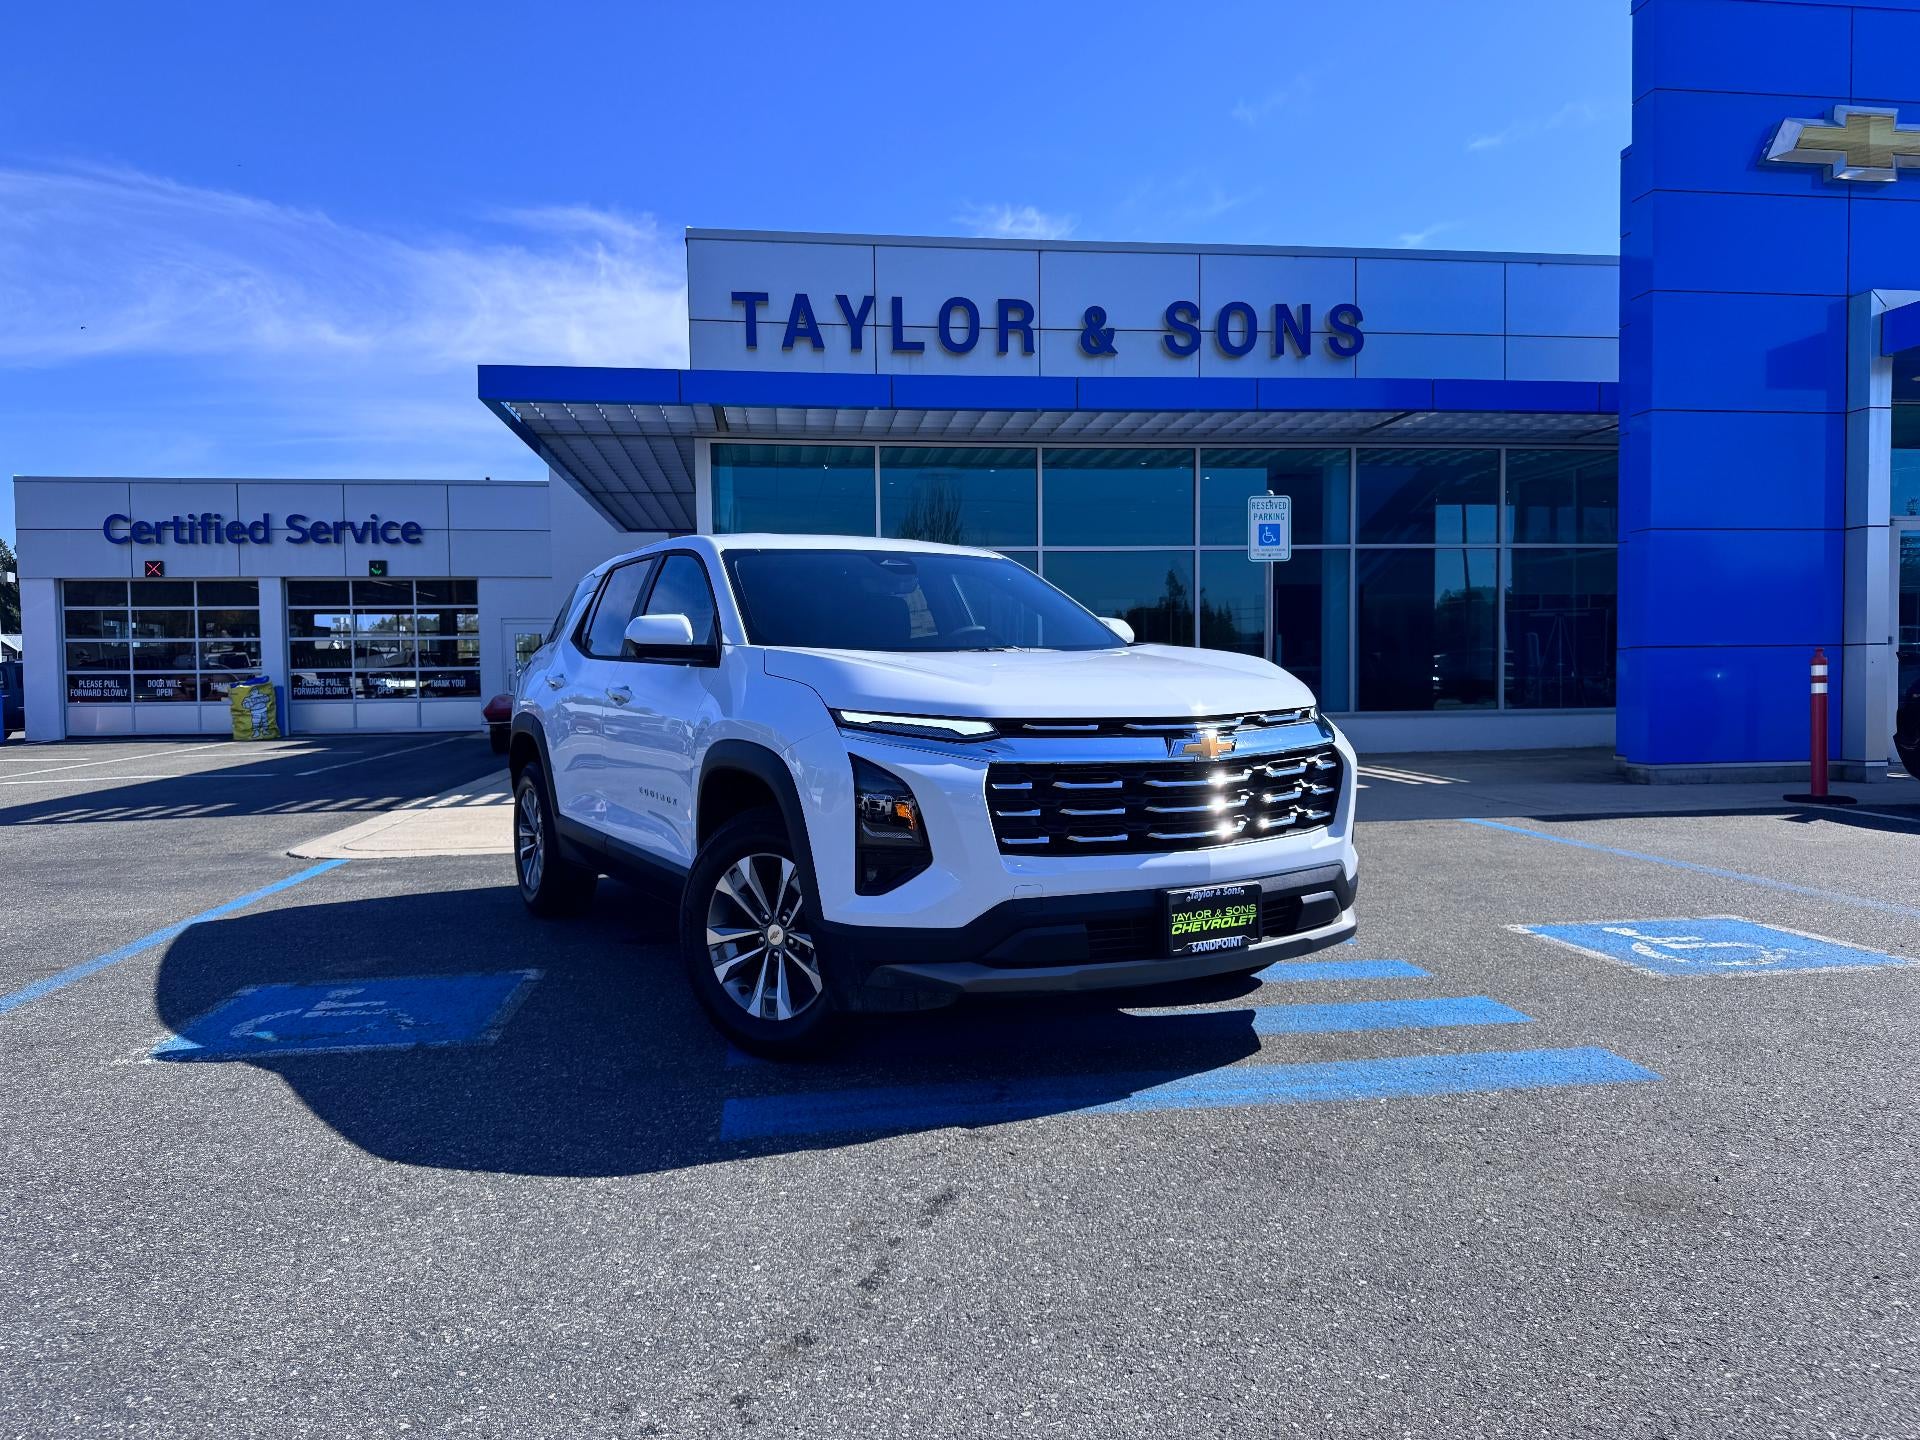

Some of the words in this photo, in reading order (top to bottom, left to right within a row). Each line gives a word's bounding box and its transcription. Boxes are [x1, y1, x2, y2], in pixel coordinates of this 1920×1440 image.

[731, 291, 1035, 355] TAYLOR
[1081, 305, 1118, 355] &
[1164, 302, 1365, 358] SONS
[1251, 501, 1287, 509] RESERVED
[1253, 512, 1285, 521] PARKING
[103, 512, 271, 545] Certified
[286, 513, 422, 545] Service
[78, 679, 103, 688] PLEASE
[104, 679, 120, 688] PULL
[147, 679, 165, 688] DOOR
[165, 679, 182, 688] WILL
[301, 678, 325, 687] PLEASE
[325, 678, 342, 687] PULL
[431, 679, 451, 688] THANK
[452, 679, 467, 688] YOU!
[70, 688, 102, 697] FORWARD
[103, 688, 128, 697] SLOWLY
[156, 688, 173, 697] OPEN
[293, 687, 324, 696] FORWARD
[325, 687, 350, 695] SLOWLY
[377, 686, 394, 695] OPEN
[1189, 890, 1214, 901] Taylor
[1223, 887, 1241, 896] Sons
[1171, 909, 1212, 922] TAYLOR
[1214, 908, 1223, 919] &
[1225, 904, 1257, 915] SONS
[1171, 914, 1257, 935] CHEVROLET
[1192, 937, 1243, 953] SANDPOINT
